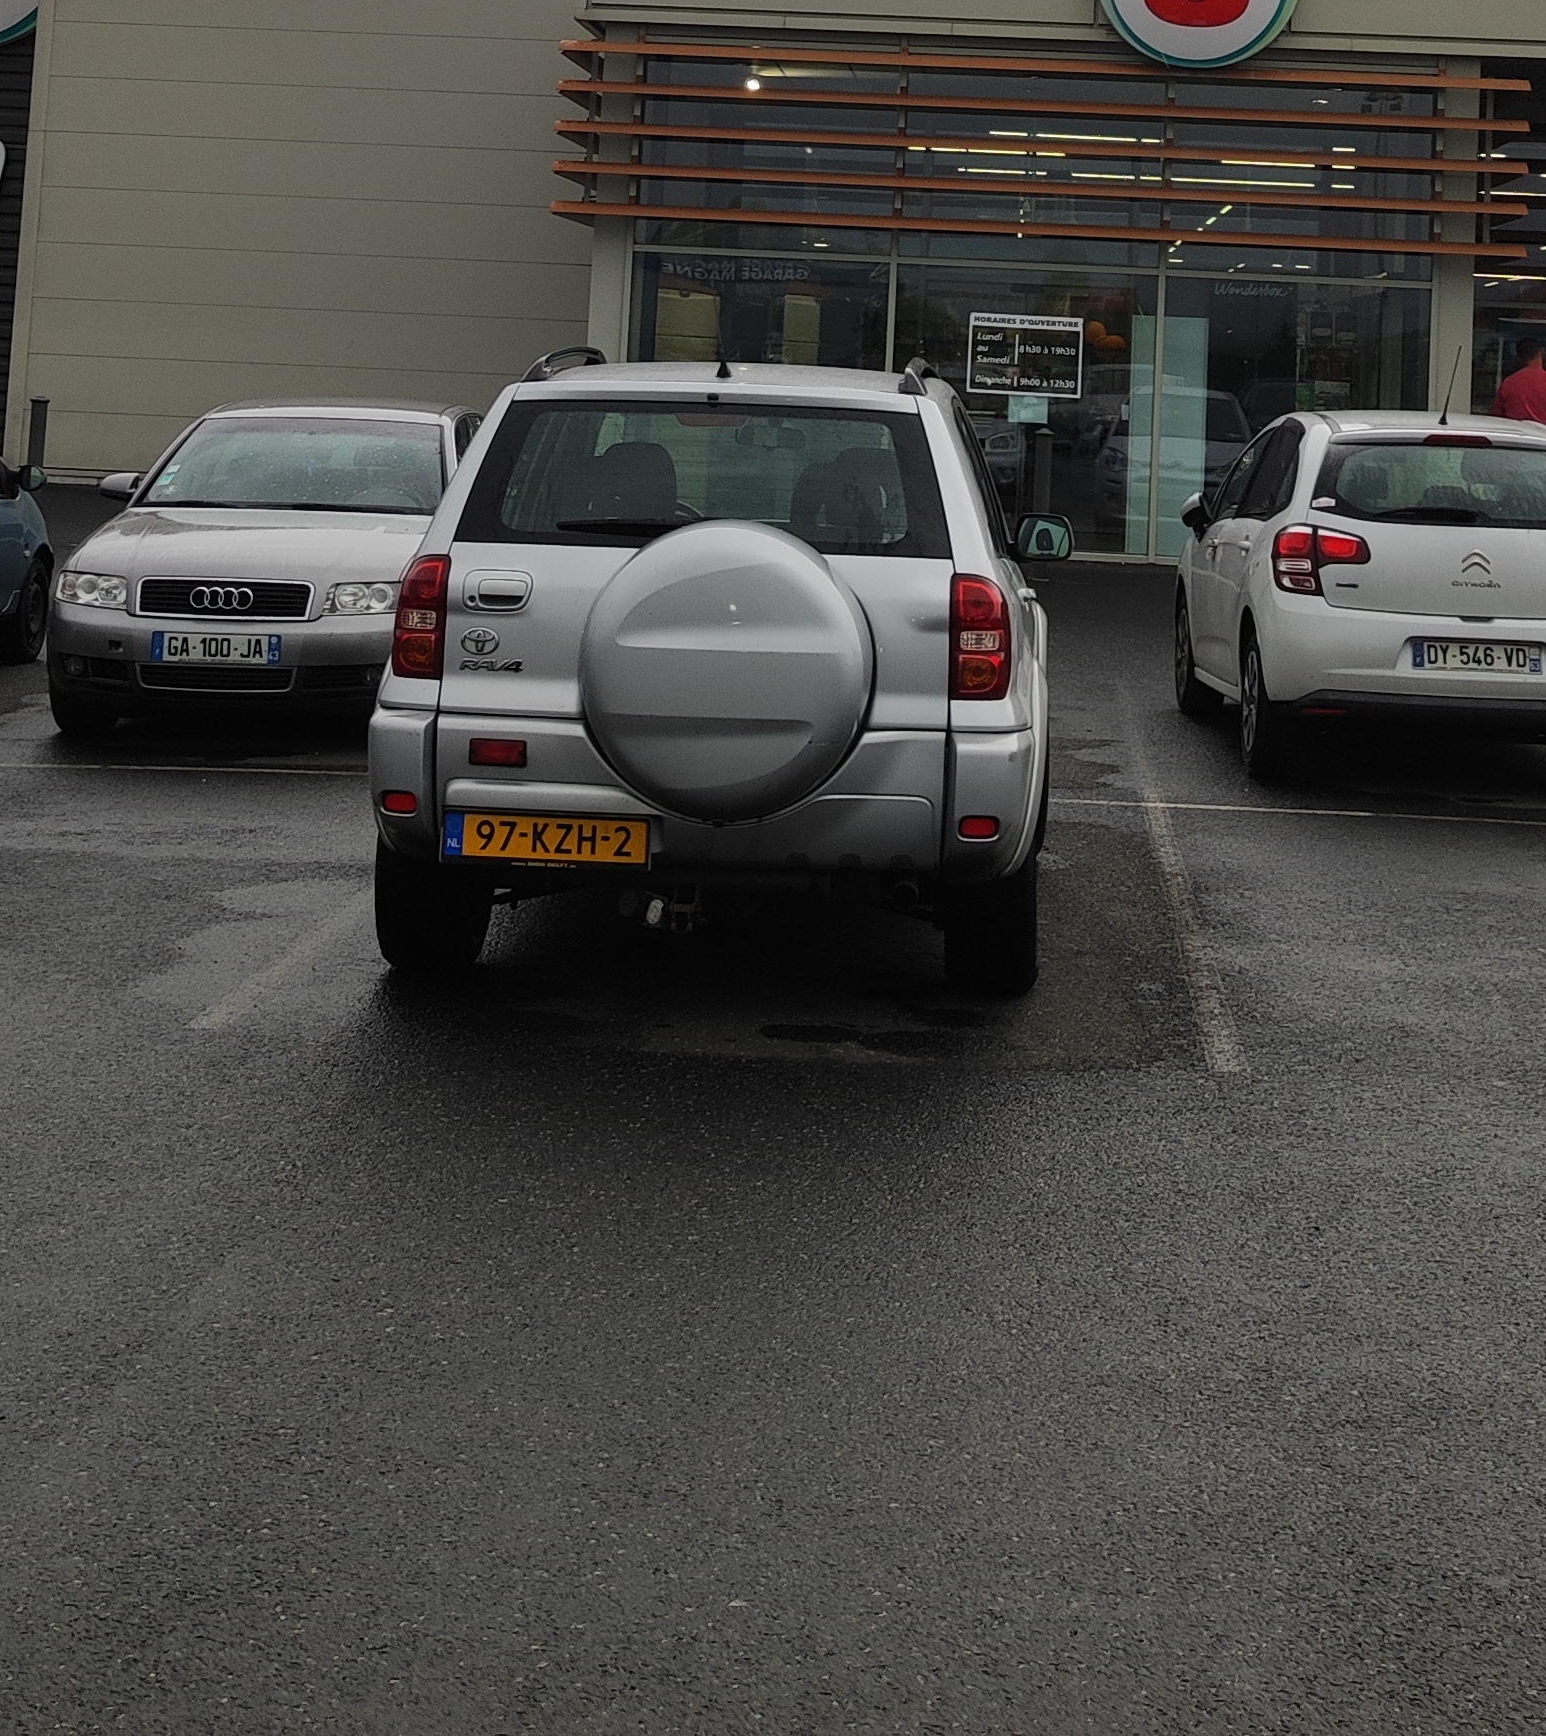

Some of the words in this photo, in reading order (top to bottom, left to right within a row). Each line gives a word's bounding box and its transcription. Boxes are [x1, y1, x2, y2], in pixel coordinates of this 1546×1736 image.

[1214, 283, 1289, 297] Wonderbox
[974, 316, 1017, 324] HORAIRES
[1019, 318, 1079, 328] D'OUVERTURE
[976, 332, 1004, 341] Lundi
[1042, 346, 1049, 354] à
[1051, 347, 1076, 356] 19h30
[975, 355, 1010, 364] Samedi
[975, 375, 1012, 385] Dimanche
[1019, 378, 1041, 386] 9h00
[1042, 379, 1048, 387] à
[1050, 380, 1076, 389] 12h30
[167, 636, 263, 659] GA-100-JA
[1427, 644, 1527, 668] DY-546-VD
[459, 657, 523, 673] RAV4
[446, 838, 461, 848] NL
[475, 819, 632, 858] 97-KZH-2
